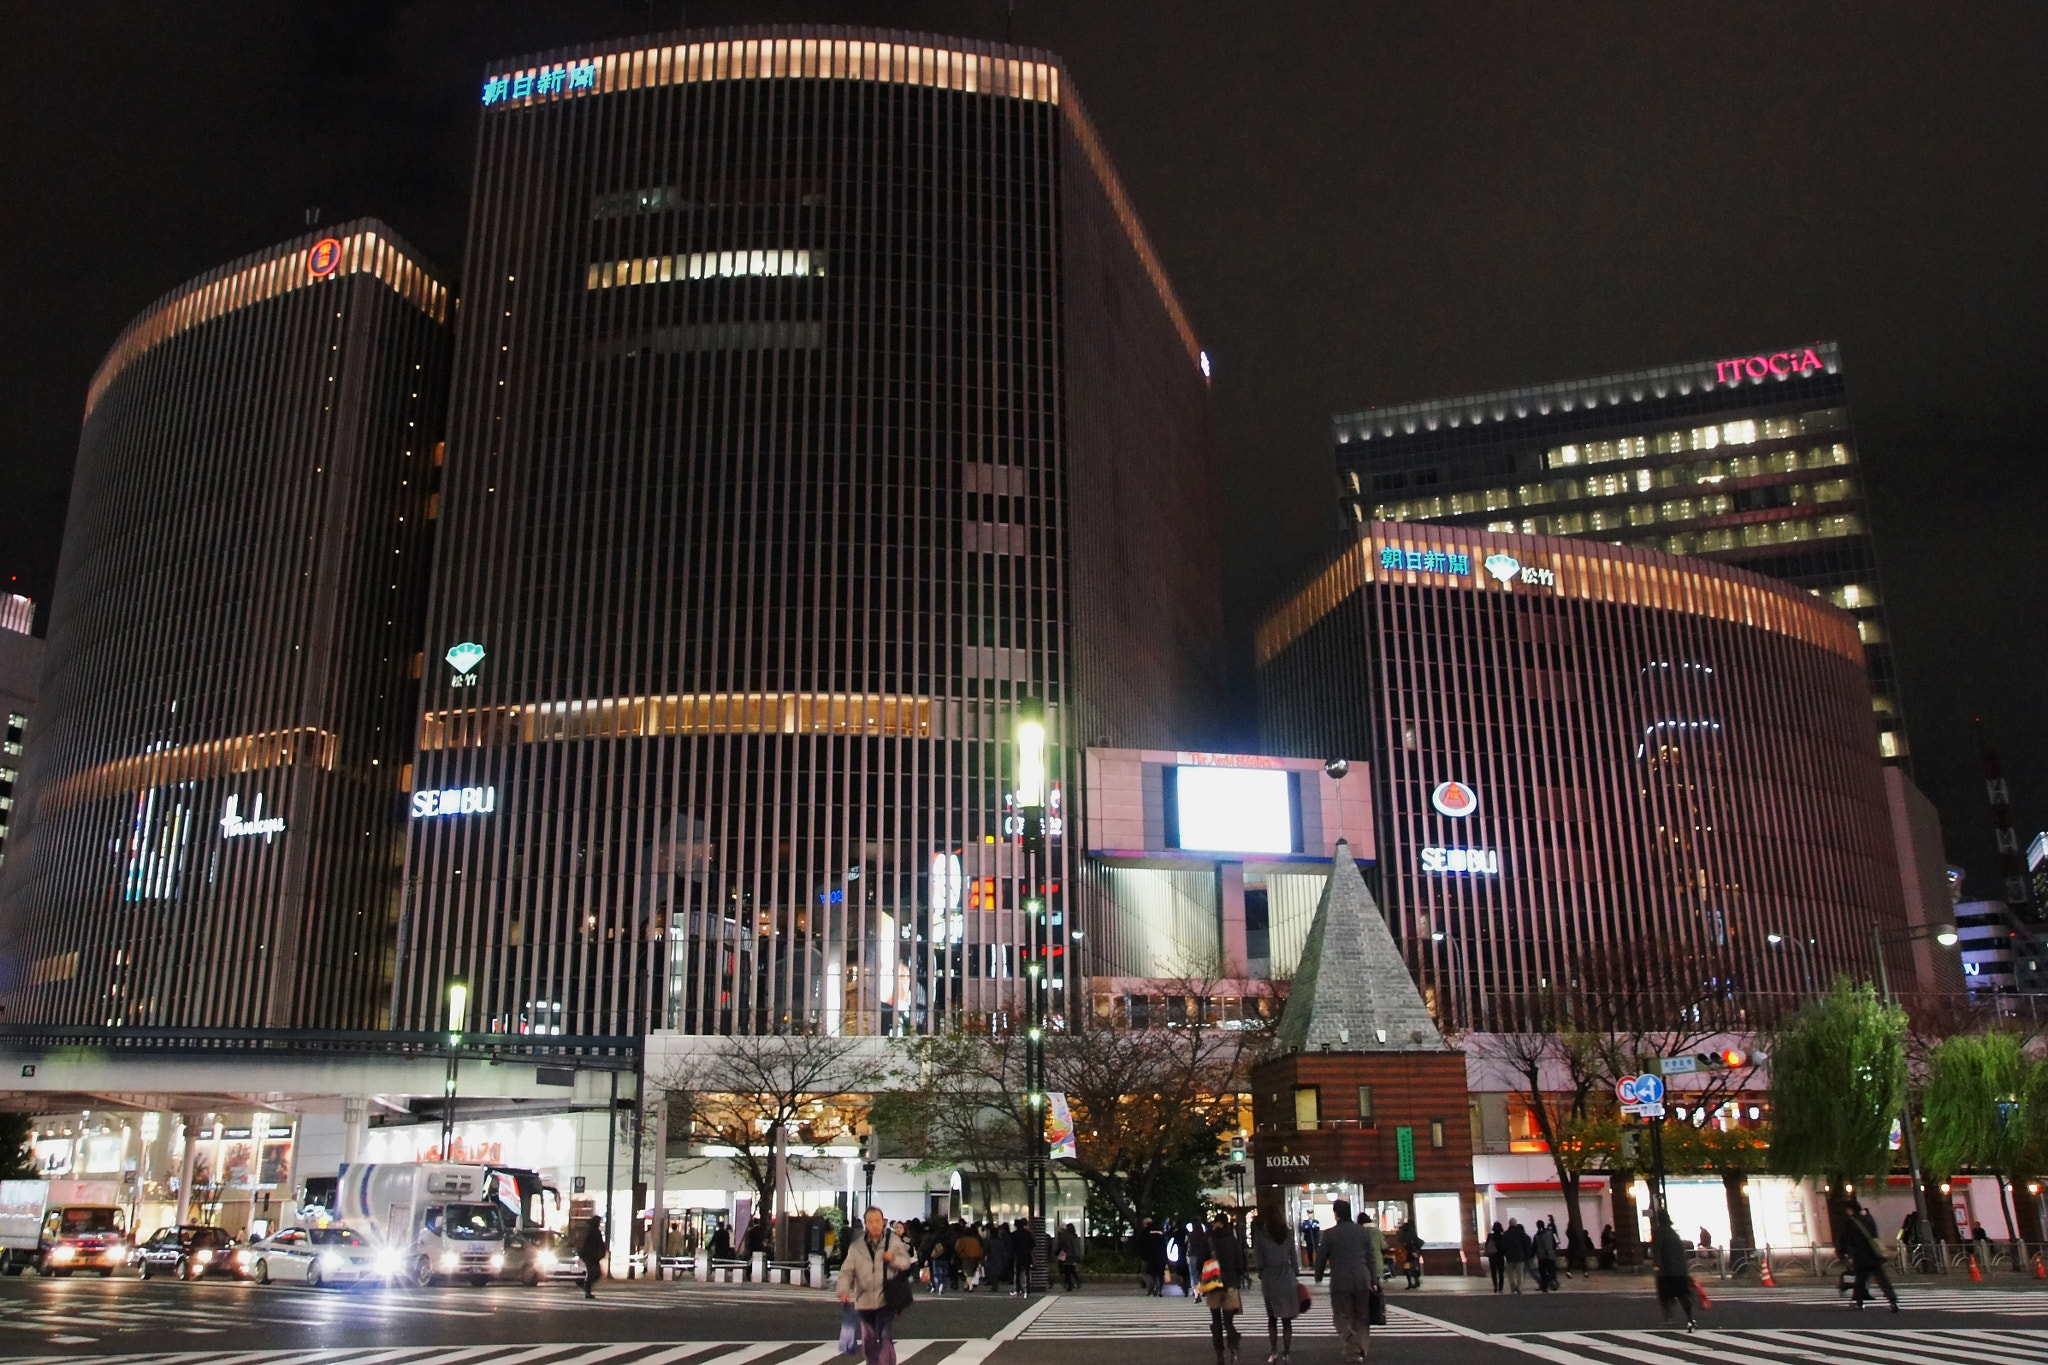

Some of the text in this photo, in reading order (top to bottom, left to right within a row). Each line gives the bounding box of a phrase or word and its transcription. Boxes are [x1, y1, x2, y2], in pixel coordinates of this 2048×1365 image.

[482, 65, 595, 106] 朝日新聞
[1381, 547, 1469, 575] 朝日新聞
[1521, 567, 1553, 586] 松竹
[451, 673, 477, 687] 松竹
[220, 793, 285, 844] Hankyu
[1266, 1155, 1310, 1167] KOBAN
